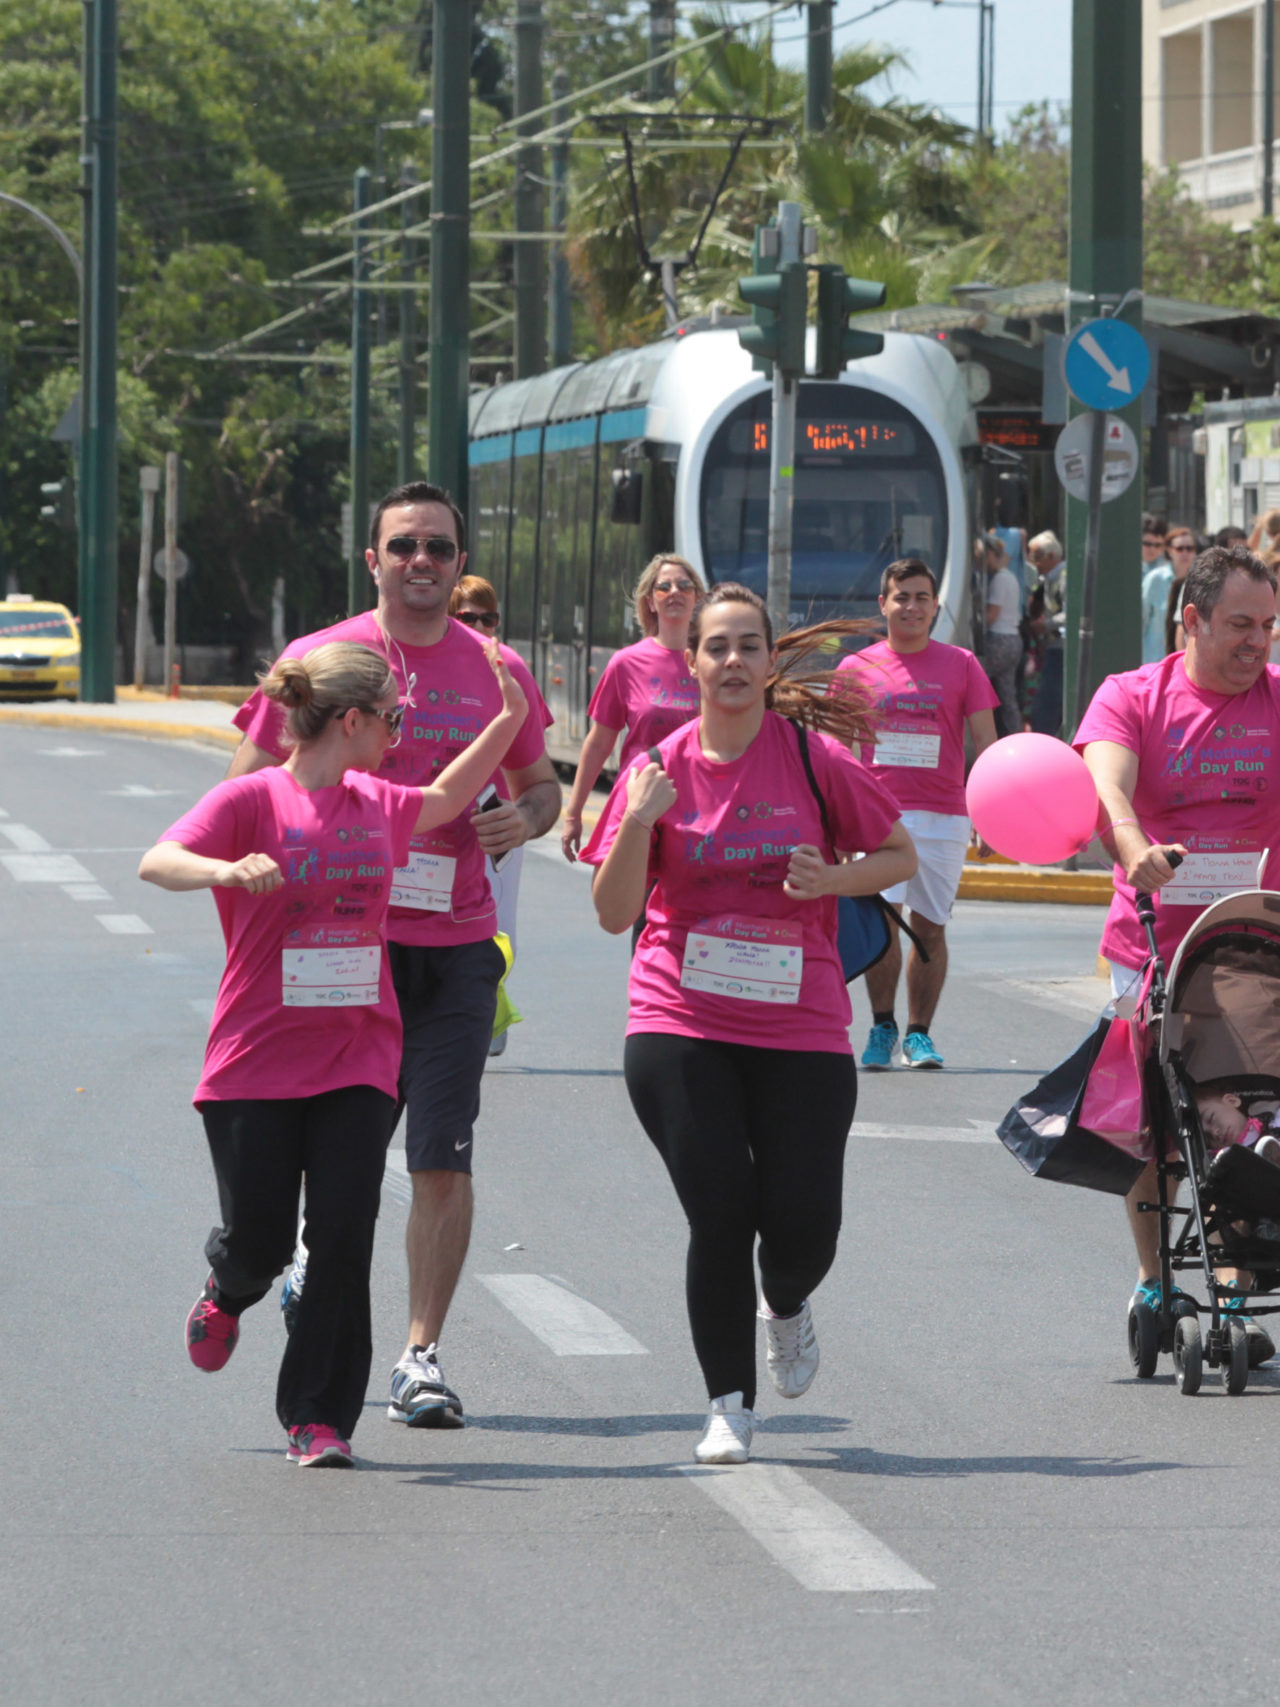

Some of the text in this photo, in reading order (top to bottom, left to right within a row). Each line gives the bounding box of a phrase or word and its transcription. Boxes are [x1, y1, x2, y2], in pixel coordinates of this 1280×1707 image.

[897, 702, 938, 711] Day Run
[413, 711, 482, 729] Mother's
[413, 726, 476, 742] Day Run
[1200, 745, 1271, 760] Mother's
[1200, 760, 1264, 775] Day Run
[723, 825, 800, 843] Mother's
[327, 848, 389, 864] Mother's
[724, 843, 795, 860] Day Run
[326, 864, 386, 881] Day Run
[734, 929, 749, 937] Day
